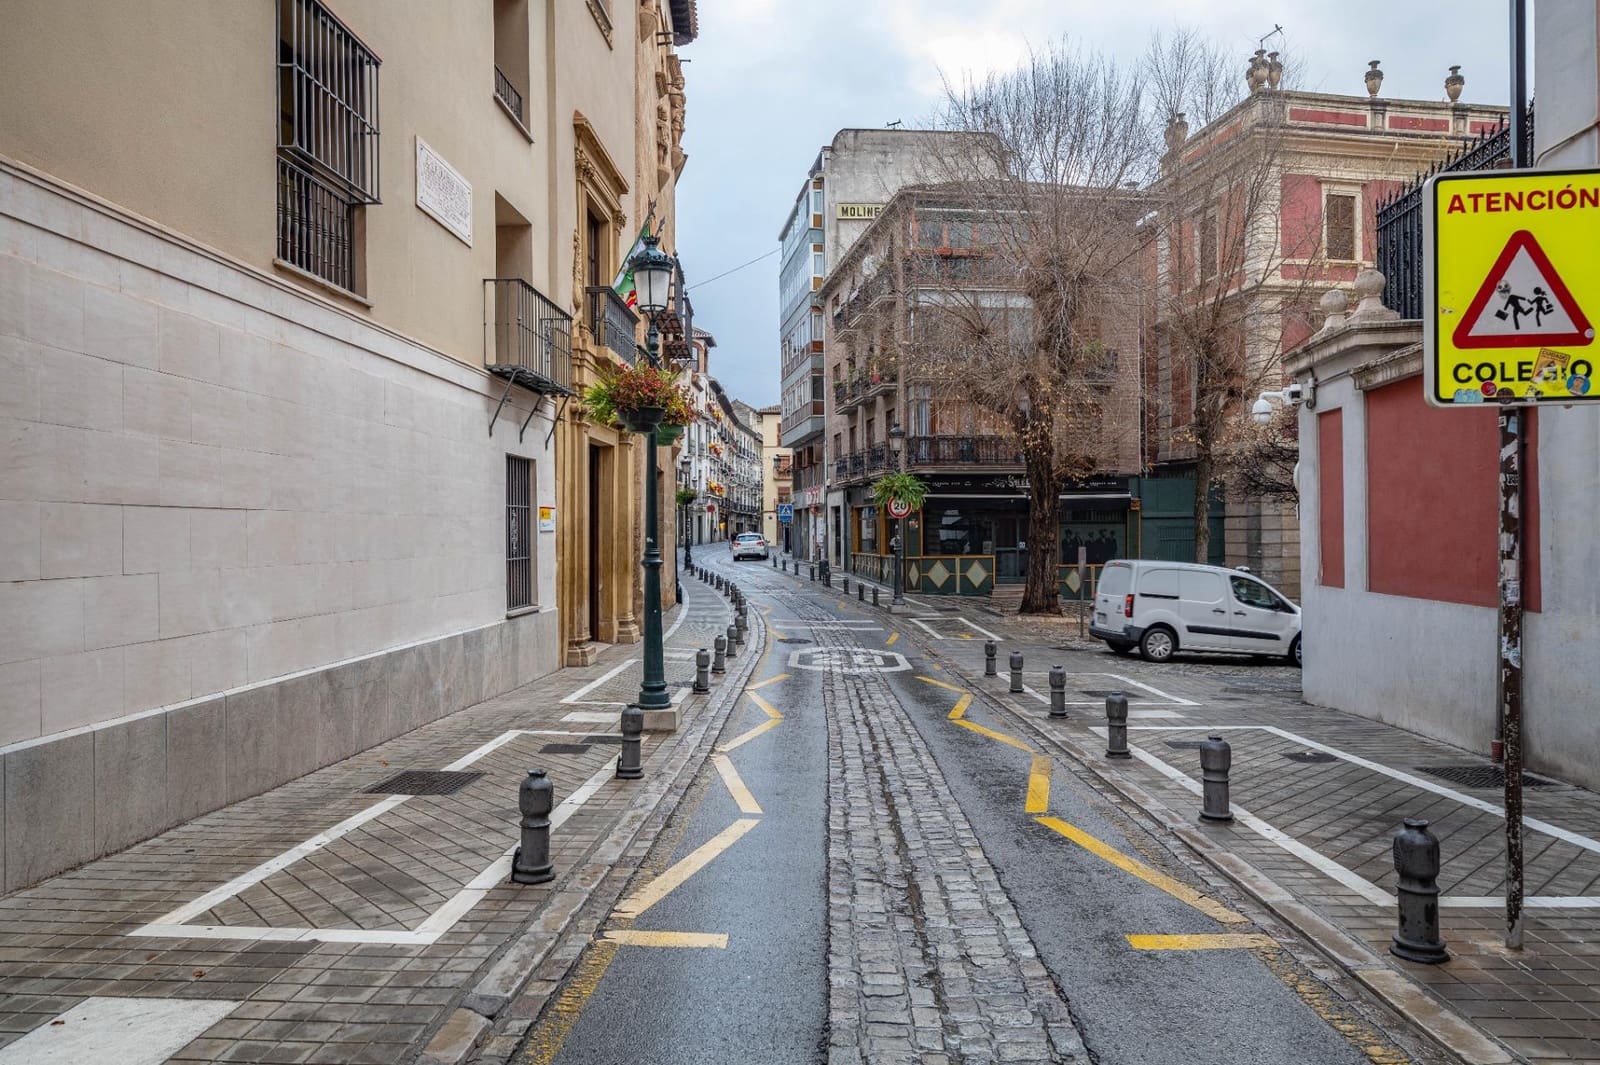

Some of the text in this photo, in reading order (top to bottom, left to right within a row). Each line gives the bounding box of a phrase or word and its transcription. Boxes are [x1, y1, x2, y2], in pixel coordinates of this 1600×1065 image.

[1447, 184, 1599, 215] ATENCIÓN
[841, 206, 885, 217] MOLINE
[894, 502, 907, 511] 20
